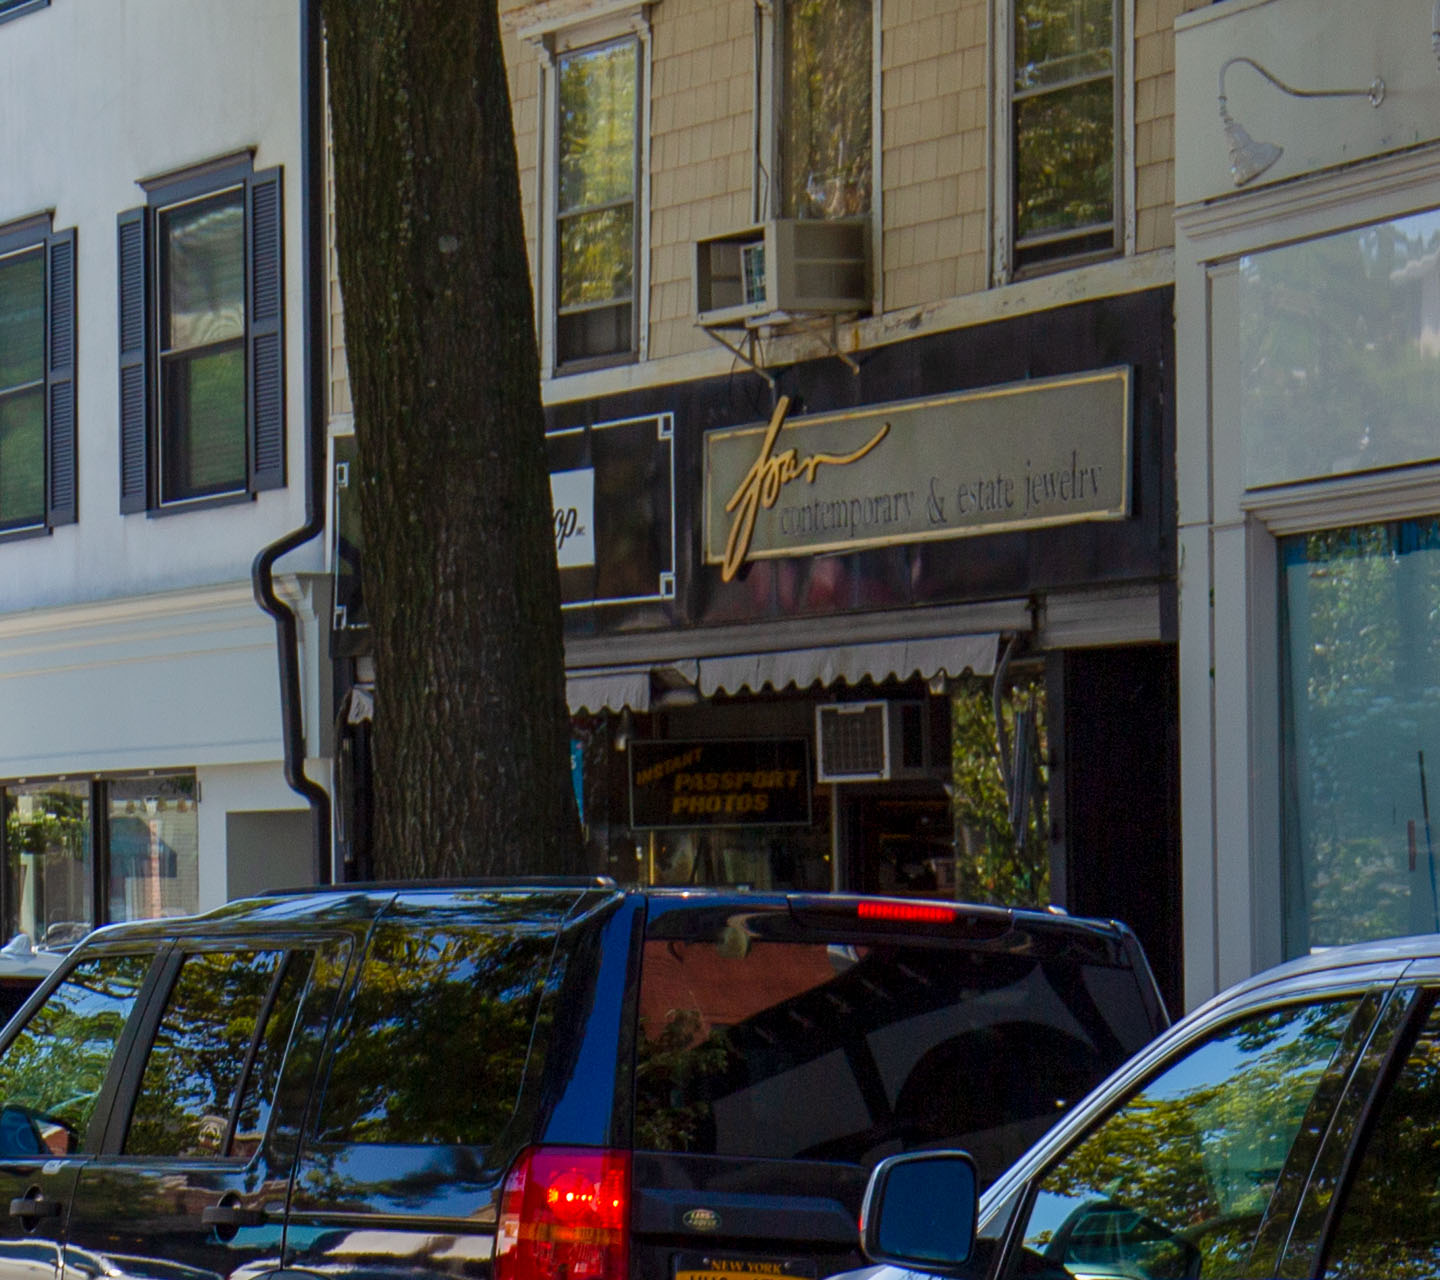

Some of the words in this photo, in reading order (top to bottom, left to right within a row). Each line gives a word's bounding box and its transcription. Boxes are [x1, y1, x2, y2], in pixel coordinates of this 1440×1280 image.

[781, 489, 915, 537] contemporary
[926, 476, 947, 524] &
[958, 472, 1015, 514] estate
[1023, 449, 1102, 516] jewelry
[674, 769, 800, 791] PASSPORT
[672, 794, 768, 814] PHOTOS
[712, 1260, 742, 1272] NEW
[747, 1263, 782, 1274] YORK
